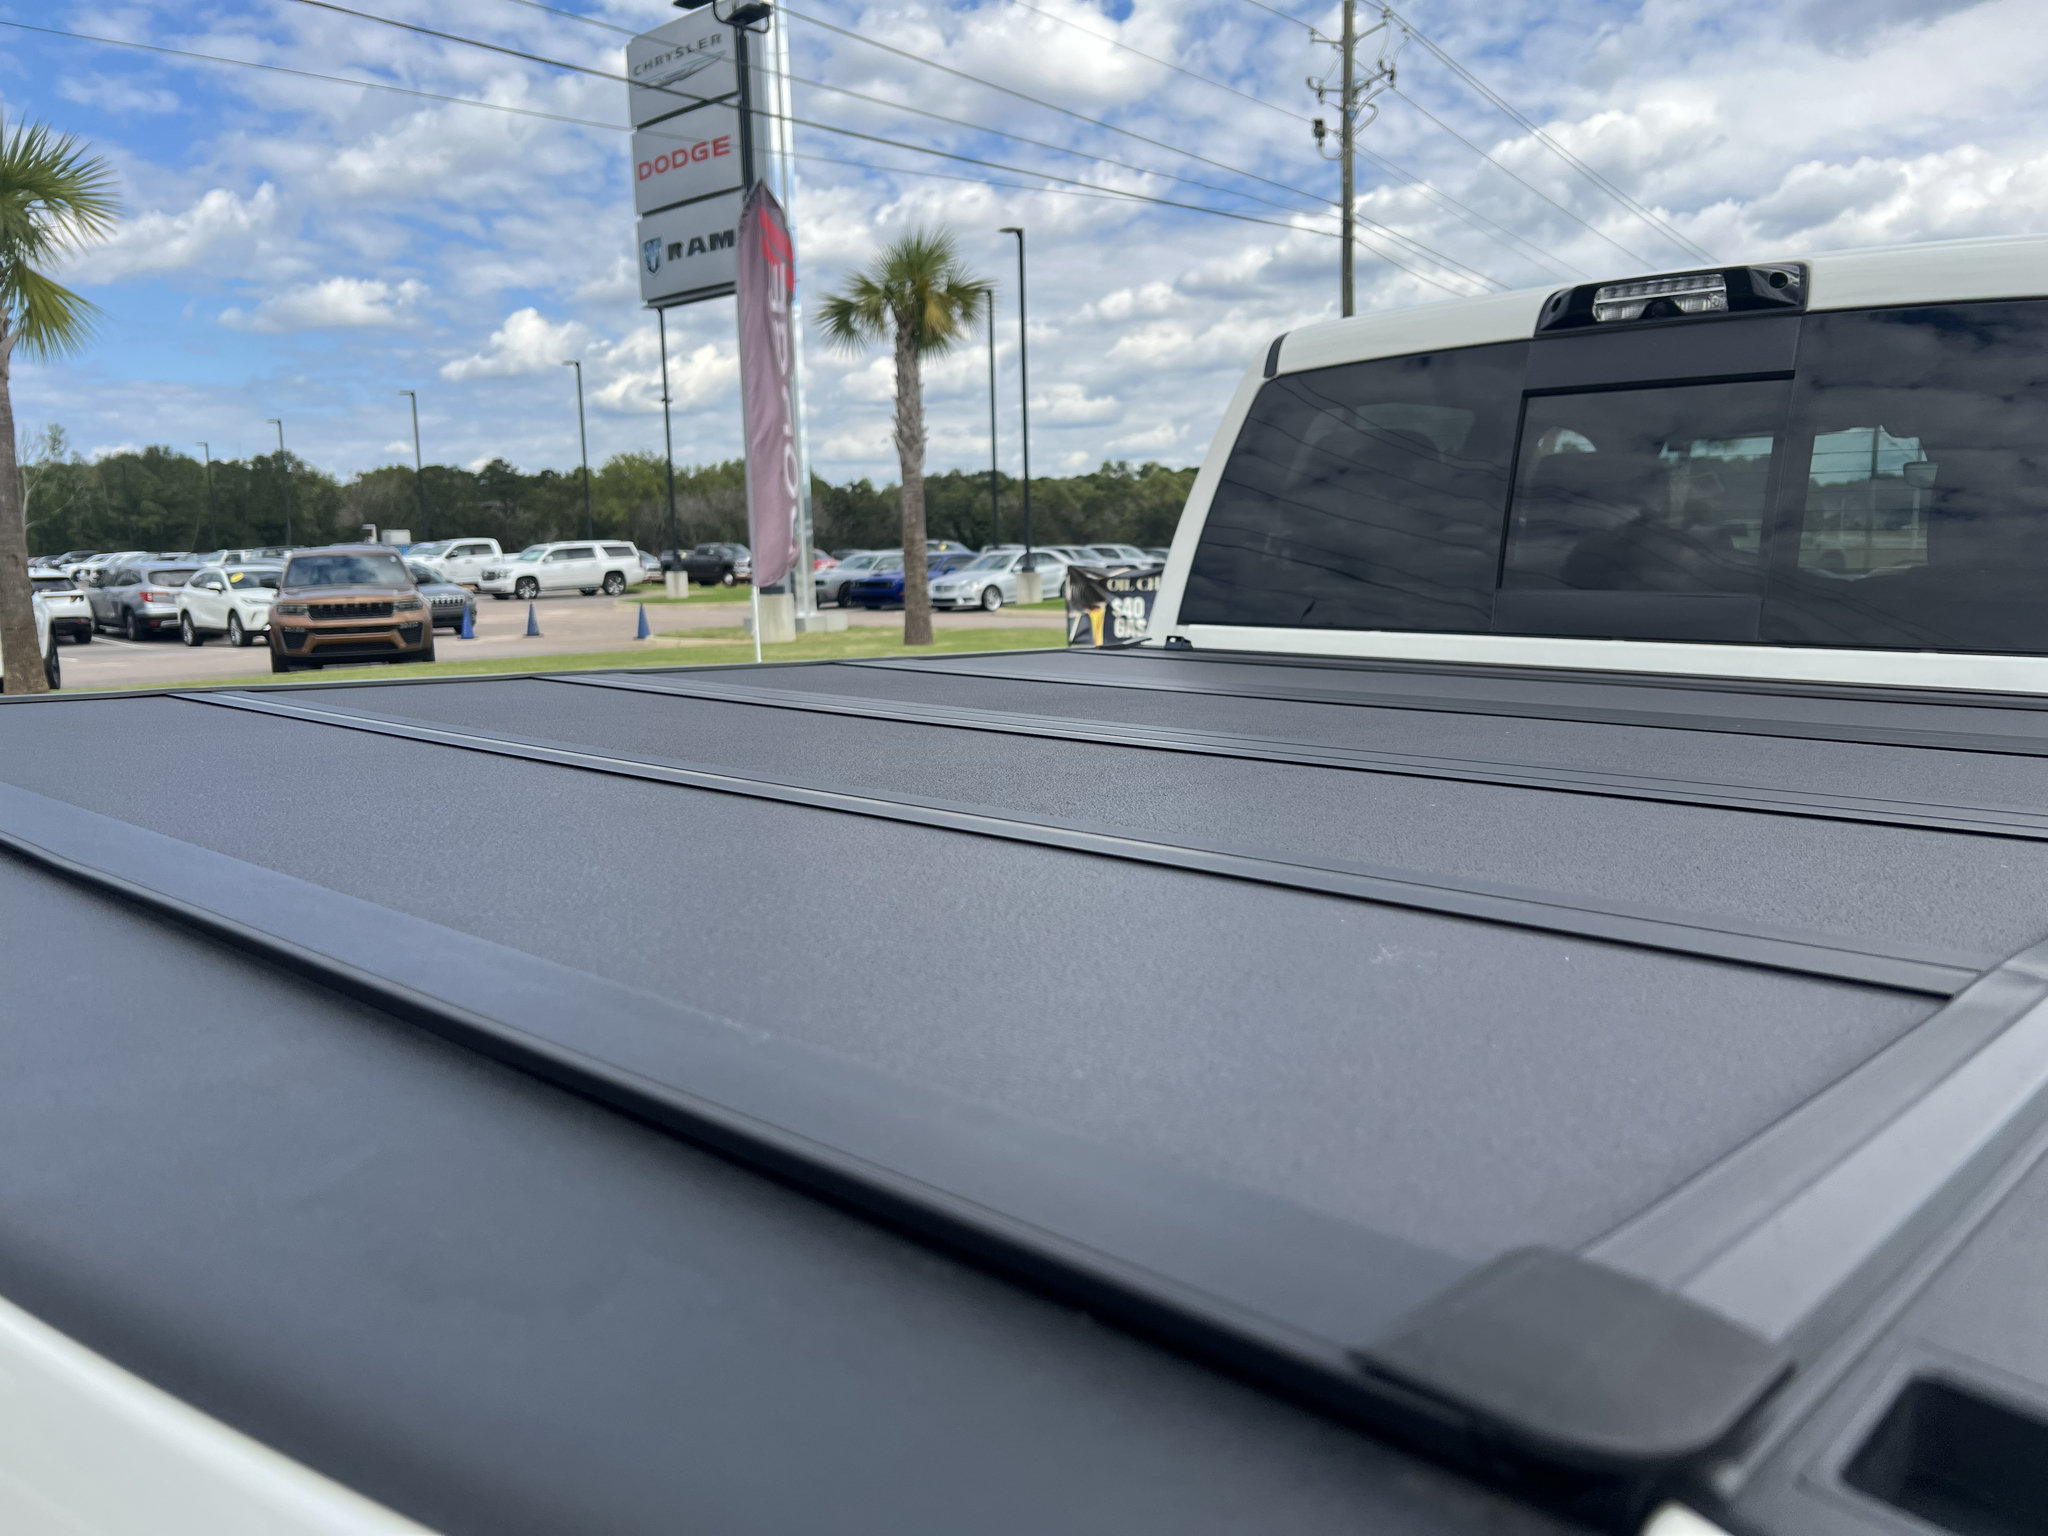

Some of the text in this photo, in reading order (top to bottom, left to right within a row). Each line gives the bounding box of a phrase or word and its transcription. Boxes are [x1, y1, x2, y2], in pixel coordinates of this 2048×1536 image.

[633, 33, 722, 77] CHRYSLER
[638, 135, 731, 181] DODGE
[668, 229, 735, 261] RAM
